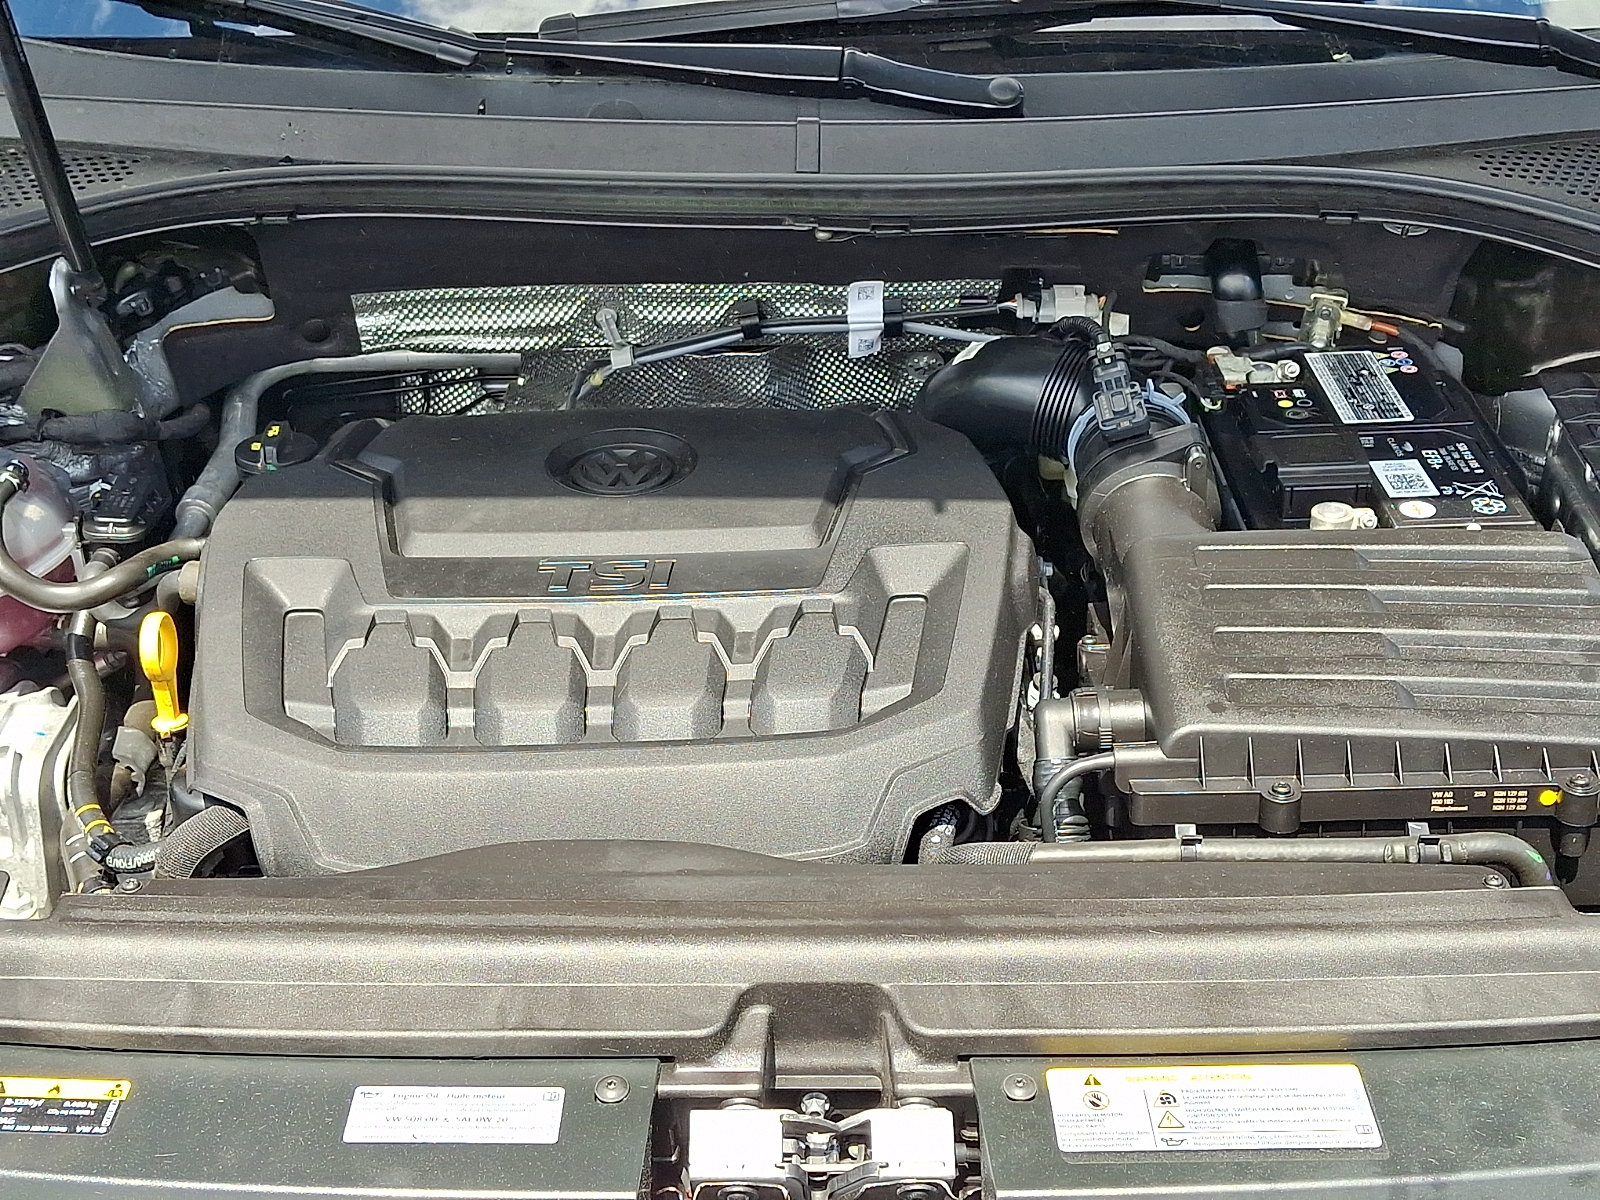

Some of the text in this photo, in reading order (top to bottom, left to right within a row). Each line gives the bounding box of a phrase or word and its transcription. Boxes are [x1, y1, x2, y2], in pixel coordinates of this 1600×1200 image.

[575, 446, 672, 490] VW
[1421, 449, 1443, 470] EFB+
[537, 559, 677, 591] TSI
[75, 1124, 92, 1133] VW
